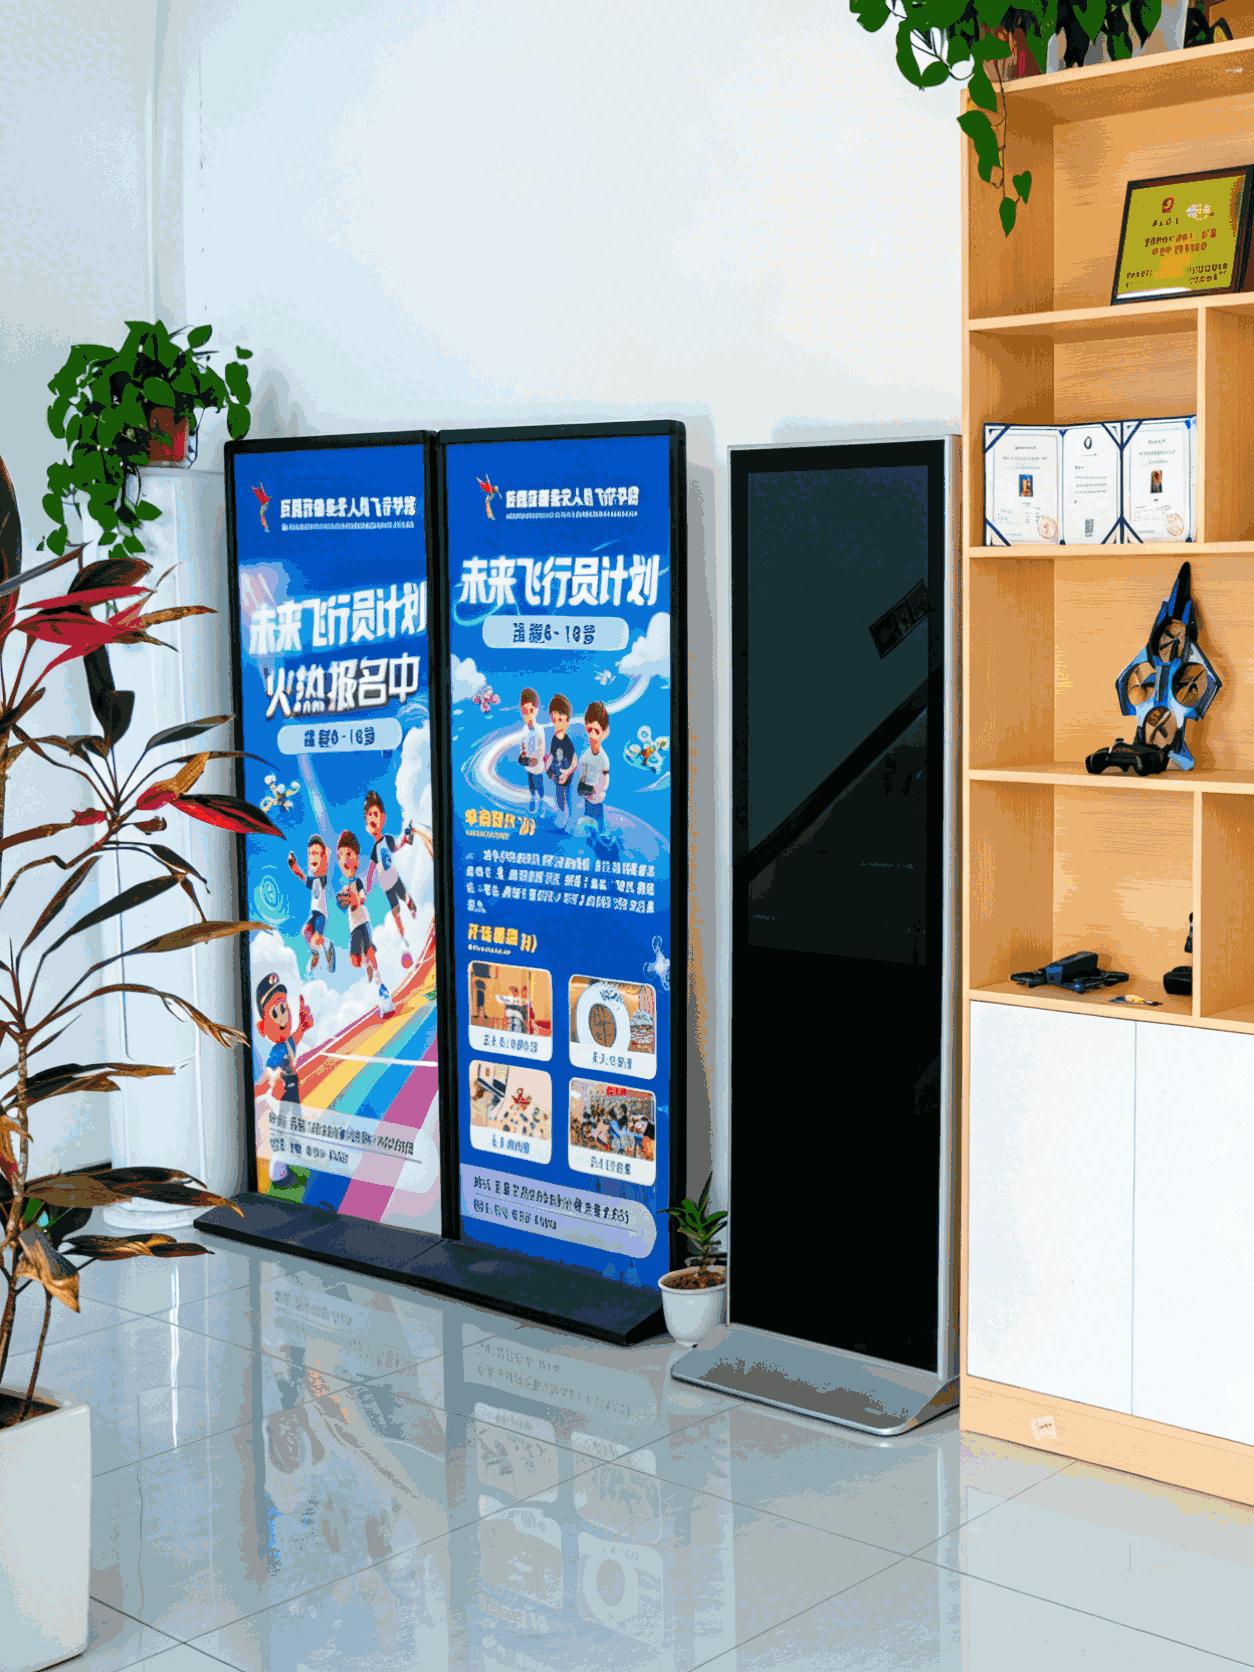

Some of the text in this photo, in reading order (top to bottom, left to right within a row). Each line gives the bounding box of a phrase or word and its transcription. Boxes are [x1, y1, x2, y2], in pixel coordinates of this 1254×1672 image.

[458, 554, 660, 608] 未来飞行员计划
[249, 581, 427, 655] 未来飞行员计划
[265, 652, 421, 718] 火热报名中
